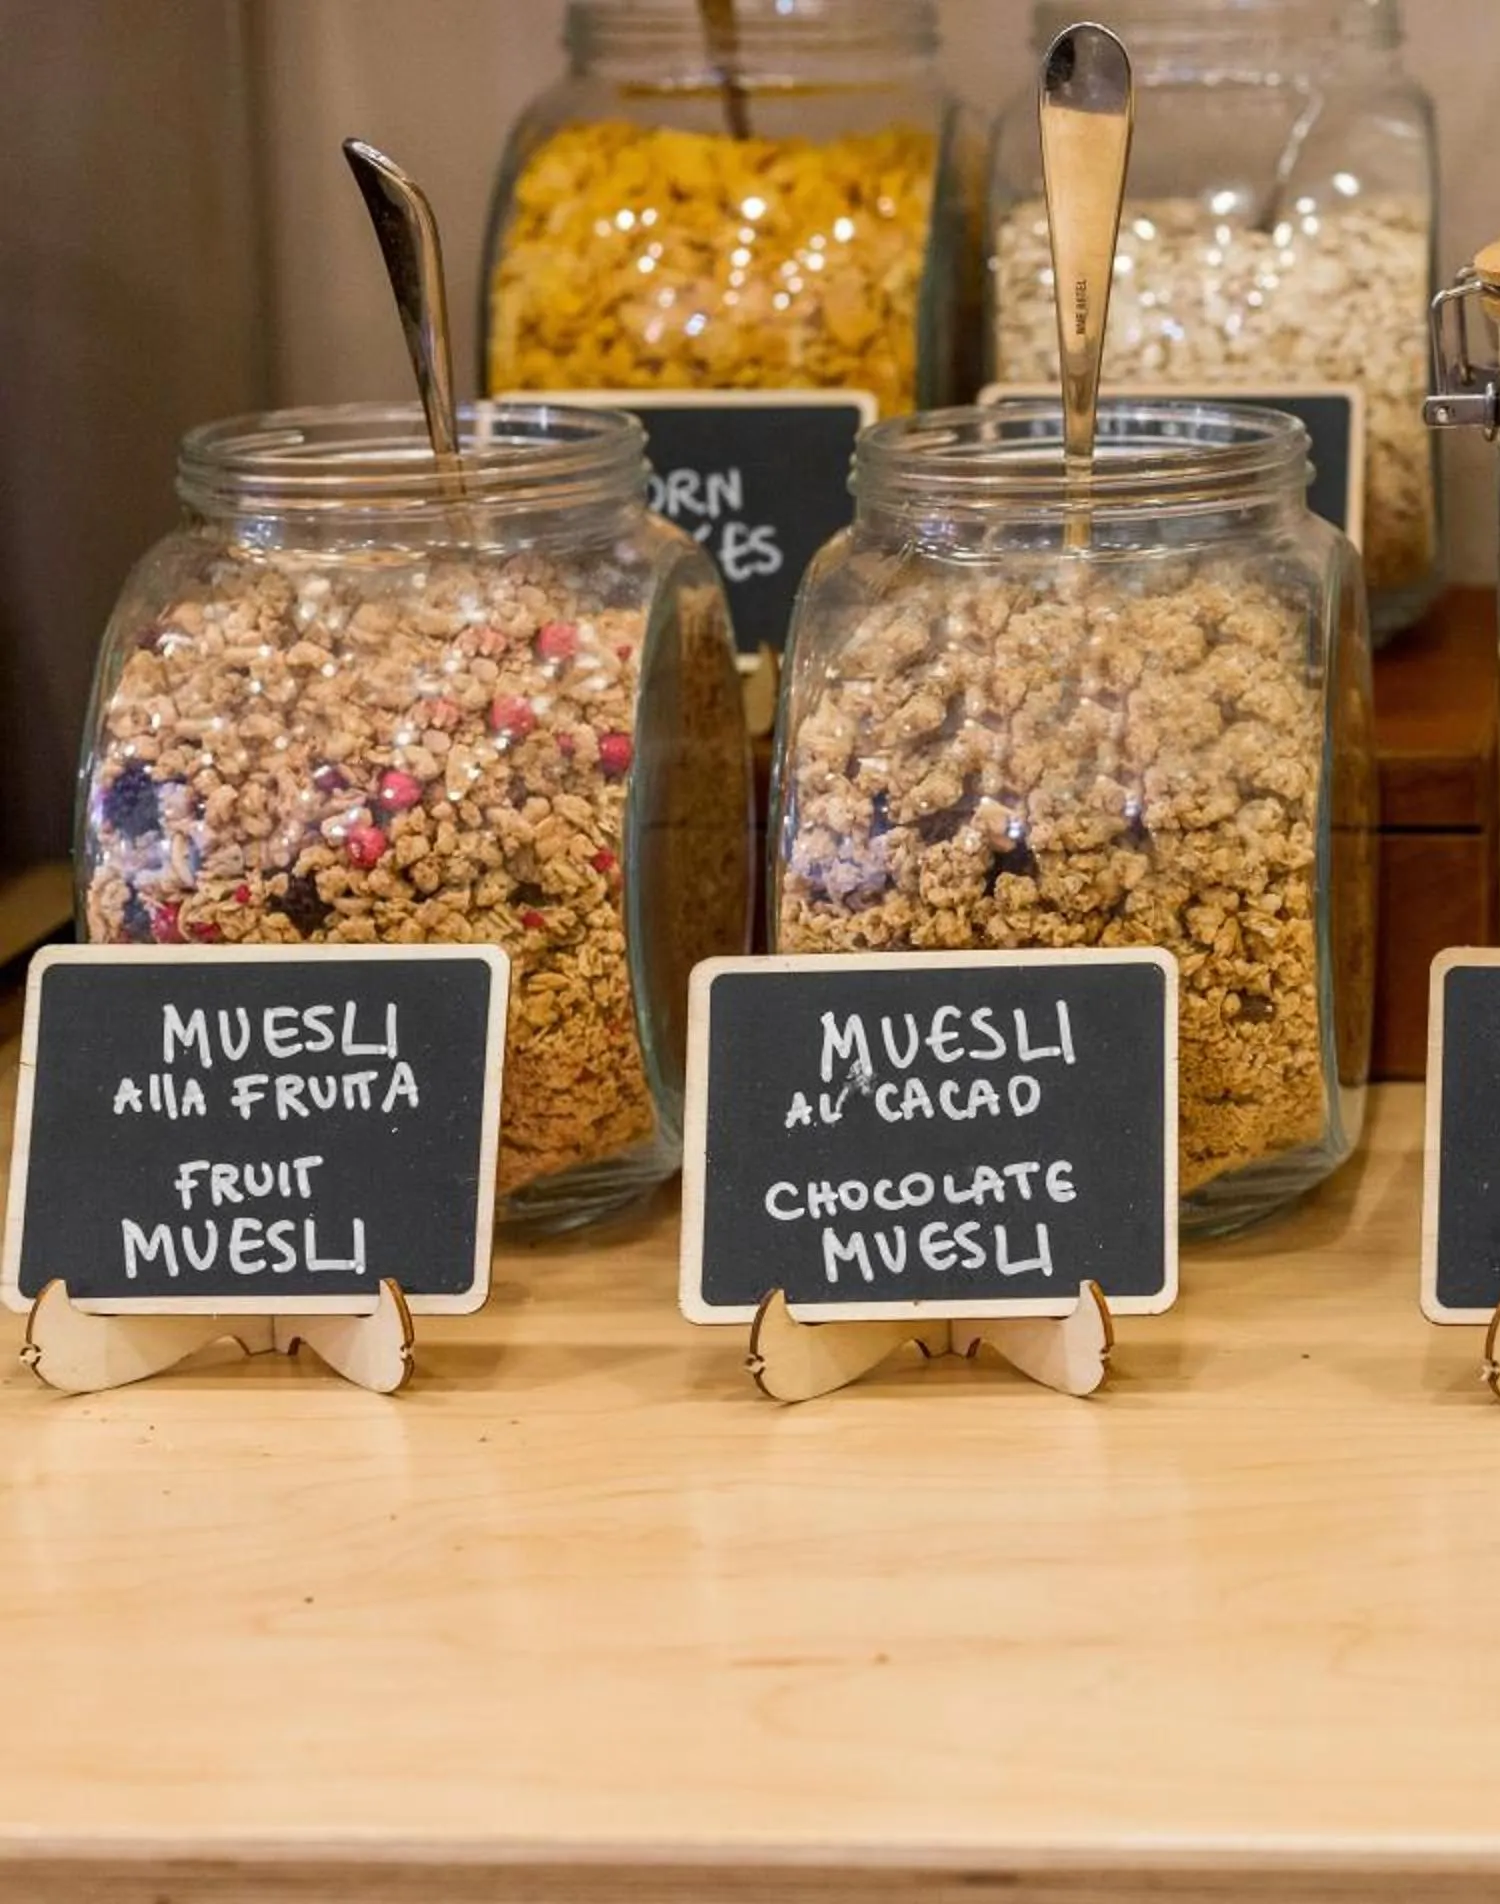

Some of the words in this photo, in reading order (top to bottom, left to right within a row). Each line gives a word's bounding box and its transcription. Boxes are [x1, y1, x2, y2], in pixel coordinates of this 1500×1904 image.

[646, 467, 743, 518] ORN
[162, 1000, 399, 1068] MUESLI
[820, 999, 1076, 1076] MUESLI
[229, 1060, 420, 1121] FRUTTA
[874, 1074, 1041, 1123] CACAO
[173, 1155, 324, 1211] FRUIT
[764, 1159, 1077, 1221] CHOCOLATE
[121, 1217, 366, 1279] MUESLI
[821, 1220, 1054, 1284] MUESLI
